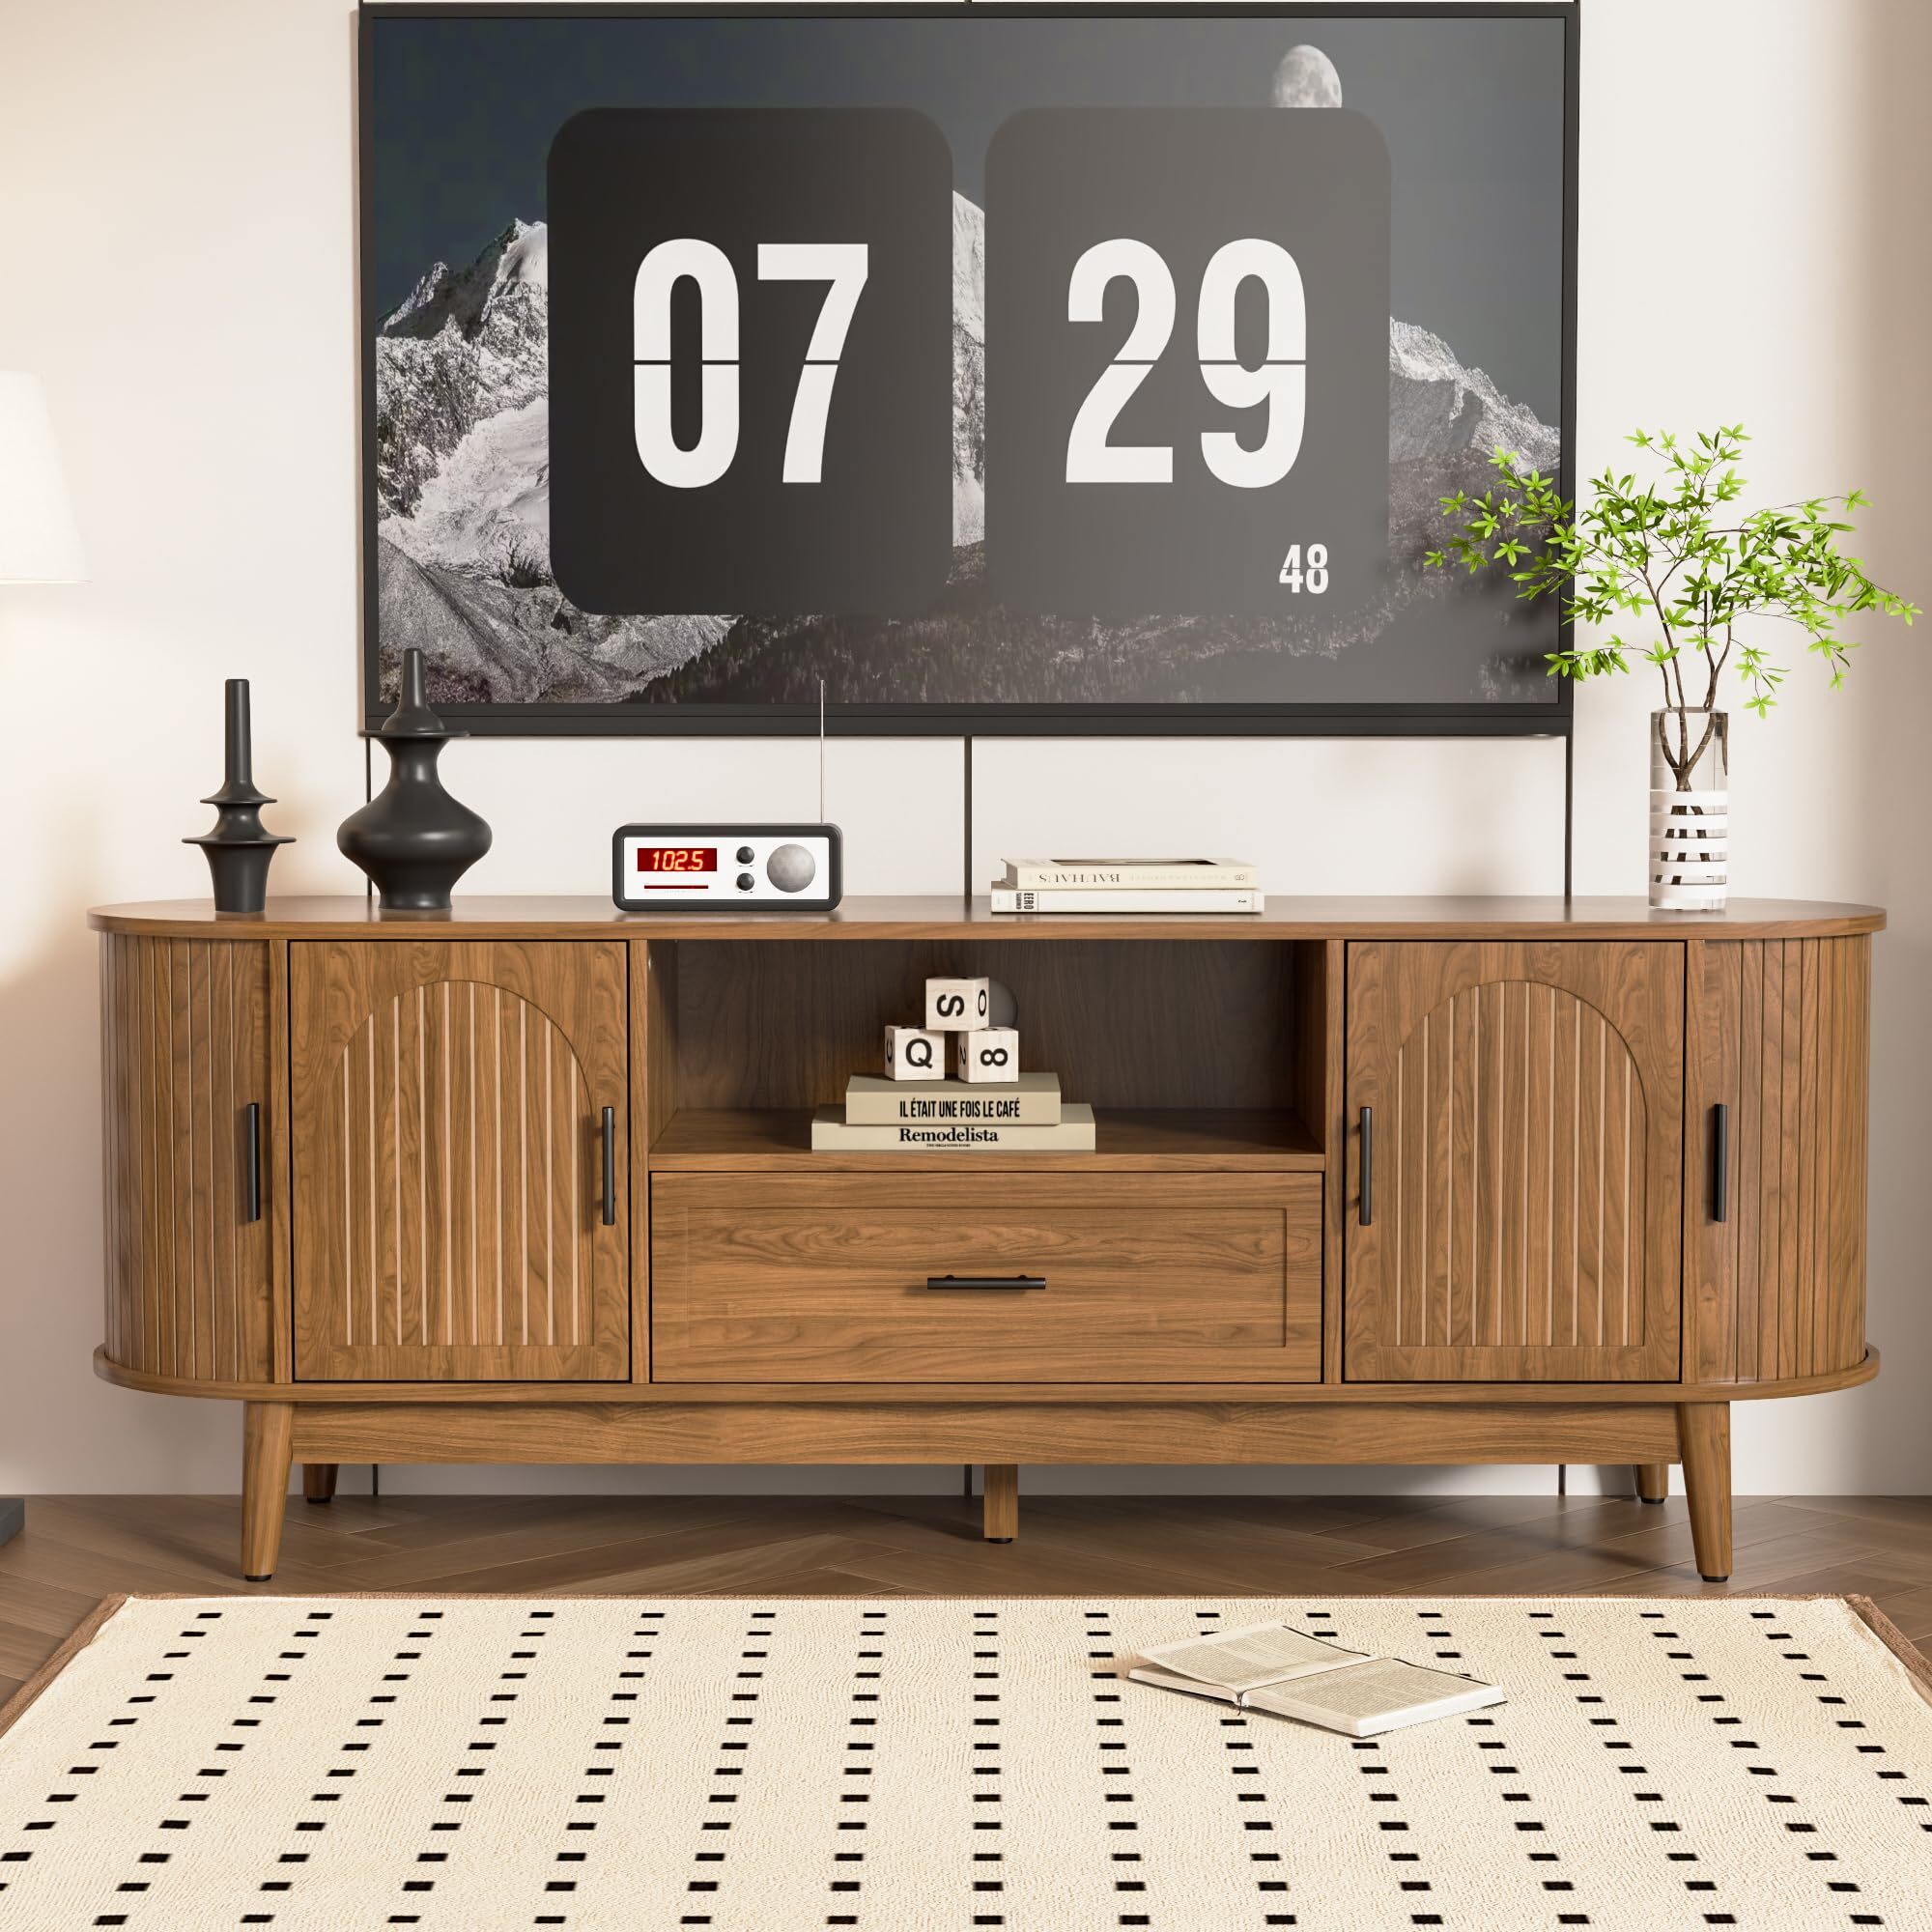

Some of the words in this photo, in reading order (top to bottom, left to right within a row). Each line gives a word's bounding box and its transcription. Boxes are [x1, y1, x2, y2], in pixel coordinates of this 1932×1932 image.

[633, 238, 869, 490] 07
[1065, 238, 1307, 490] 29
[1278, 544, 1330, 595] 48
[652, 850, 704, 871] 102.5
[1038, 873, 1121, 883] BAUHAUS
[1024, 893, 1035, 910] EERO
[936, 994, 965, 1017] S
[905, 1037, 933, 1069] Q
[980, 1048, 1009, 1067] 8
[899, 1100, 909, 1118] IL
[911, 1097, 937, 1118] ÉTAIT
[939, 1100, 958, 1118] UNE
[960, 1100, 980, 1118] FOIS
[982, 1100, 994, 1118] LE
[996, 1097, 1020, 1118] CAFÉ
[899, 1127, 999, 1143] Remodelista
